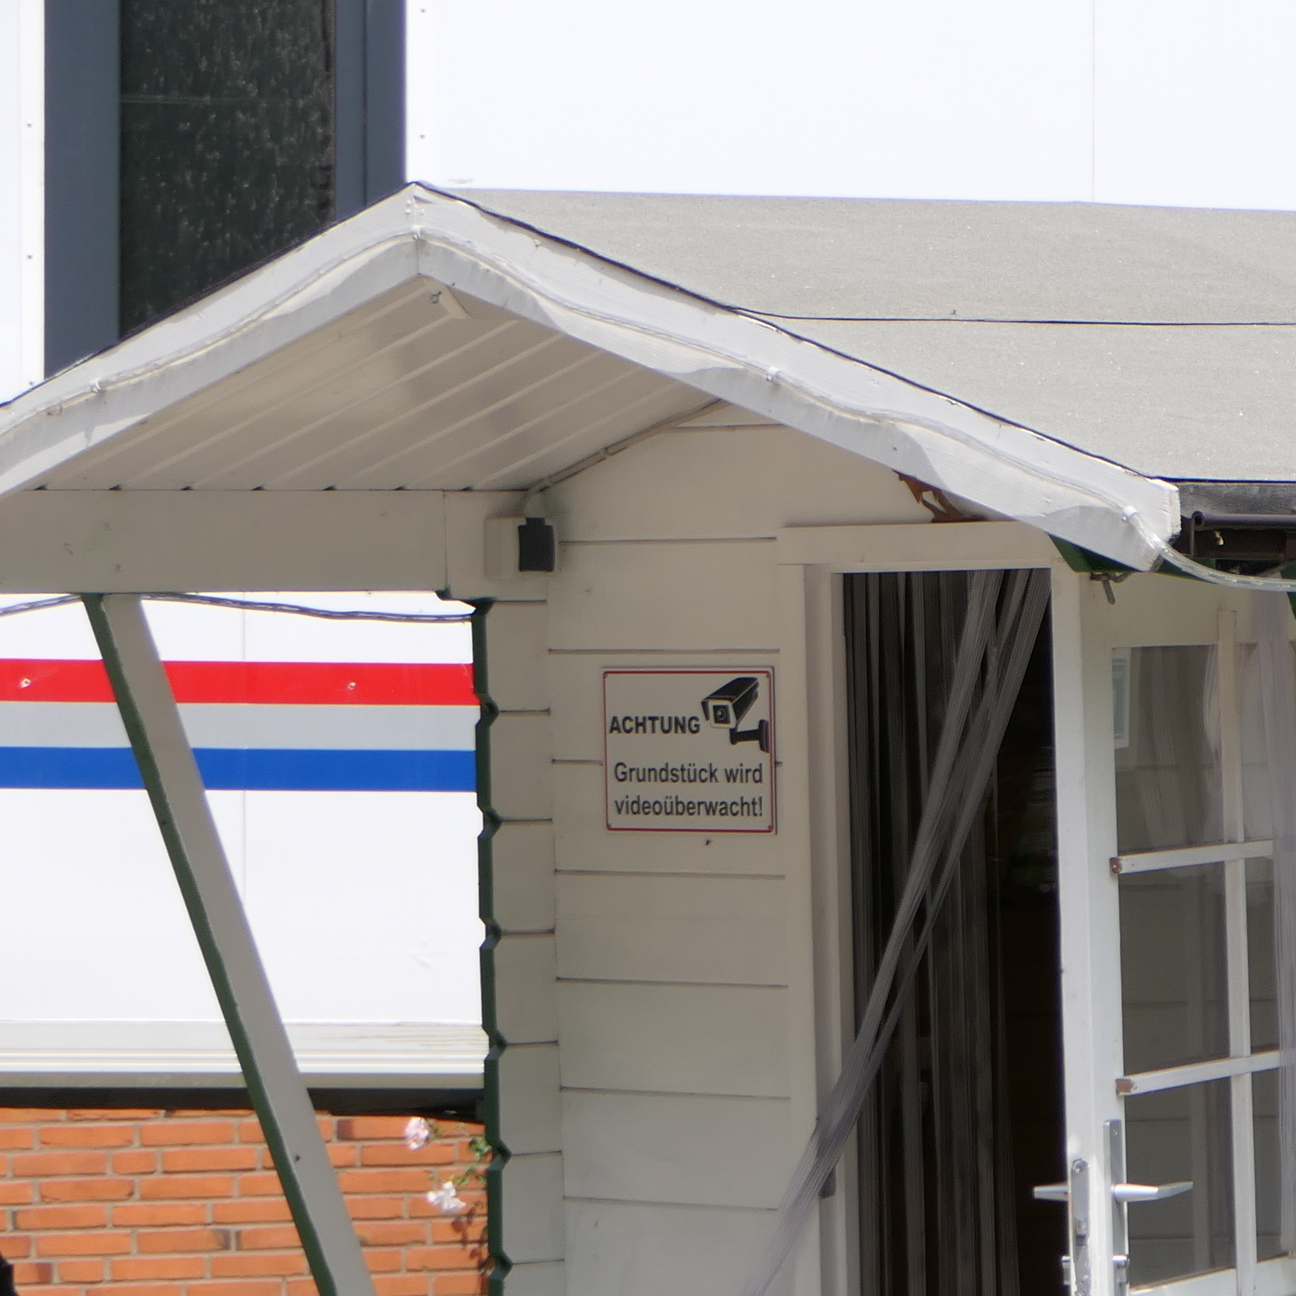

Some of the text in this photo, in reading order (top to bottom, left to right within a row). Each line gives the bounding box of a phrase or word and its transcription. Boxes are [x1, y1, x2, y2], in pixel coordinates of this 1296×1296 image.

[609, 716, 700, 734] ACHTUNG
[614, 762, 763, 783] Grundstück wird
[615, 795, 763, 816] videoüberwacht!
